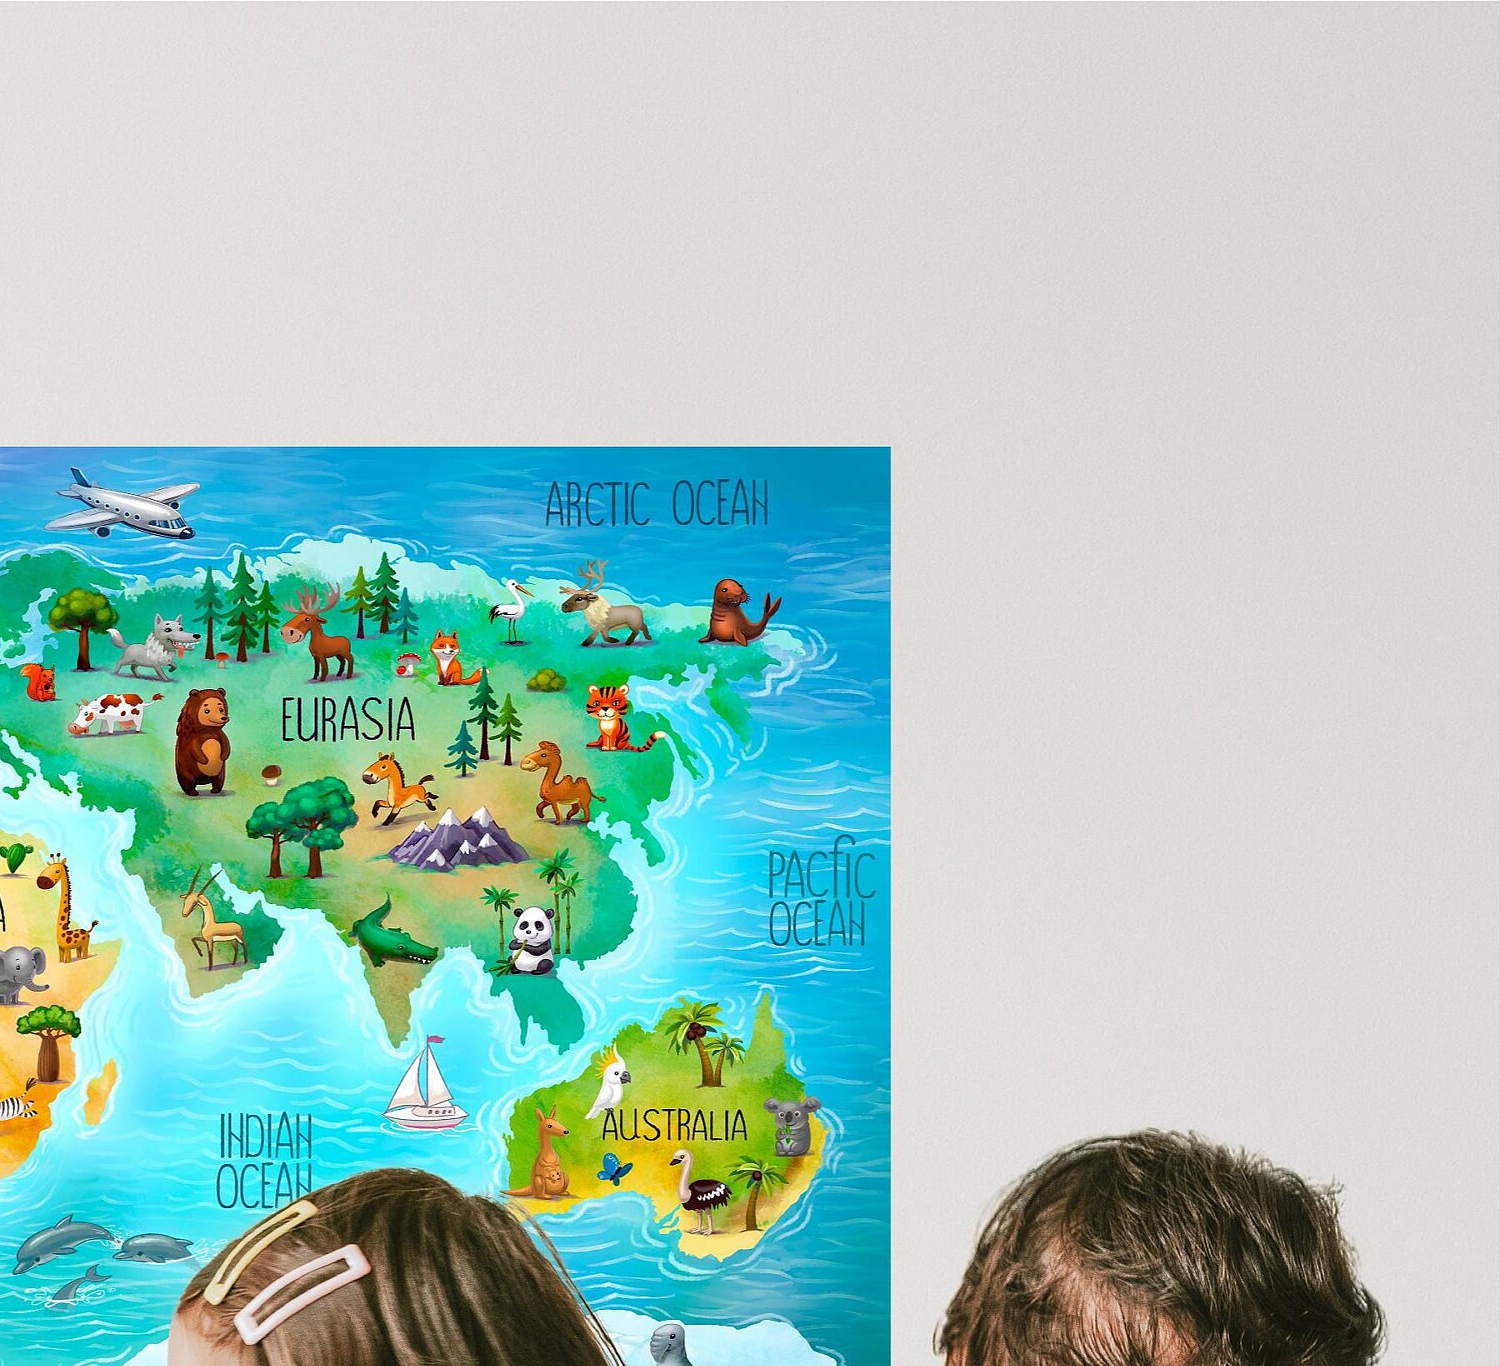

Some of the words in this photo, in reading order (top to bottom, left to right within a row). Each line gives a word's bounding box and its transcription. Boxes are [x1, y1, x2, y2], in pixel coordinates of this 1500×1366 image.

[545, 480, 651, 527] ARCTIC
[672, 478, 768, 526] OCEAN
[282, 695, 416, 742] EURASIA
[769, 899, 865, 947] OCEAN
[220, 1111, 312, 1160] INDIAN
[602, 1107, 748, 1142] AUSTRALIA
[216, 1161, 312, 1209] OCEAN
